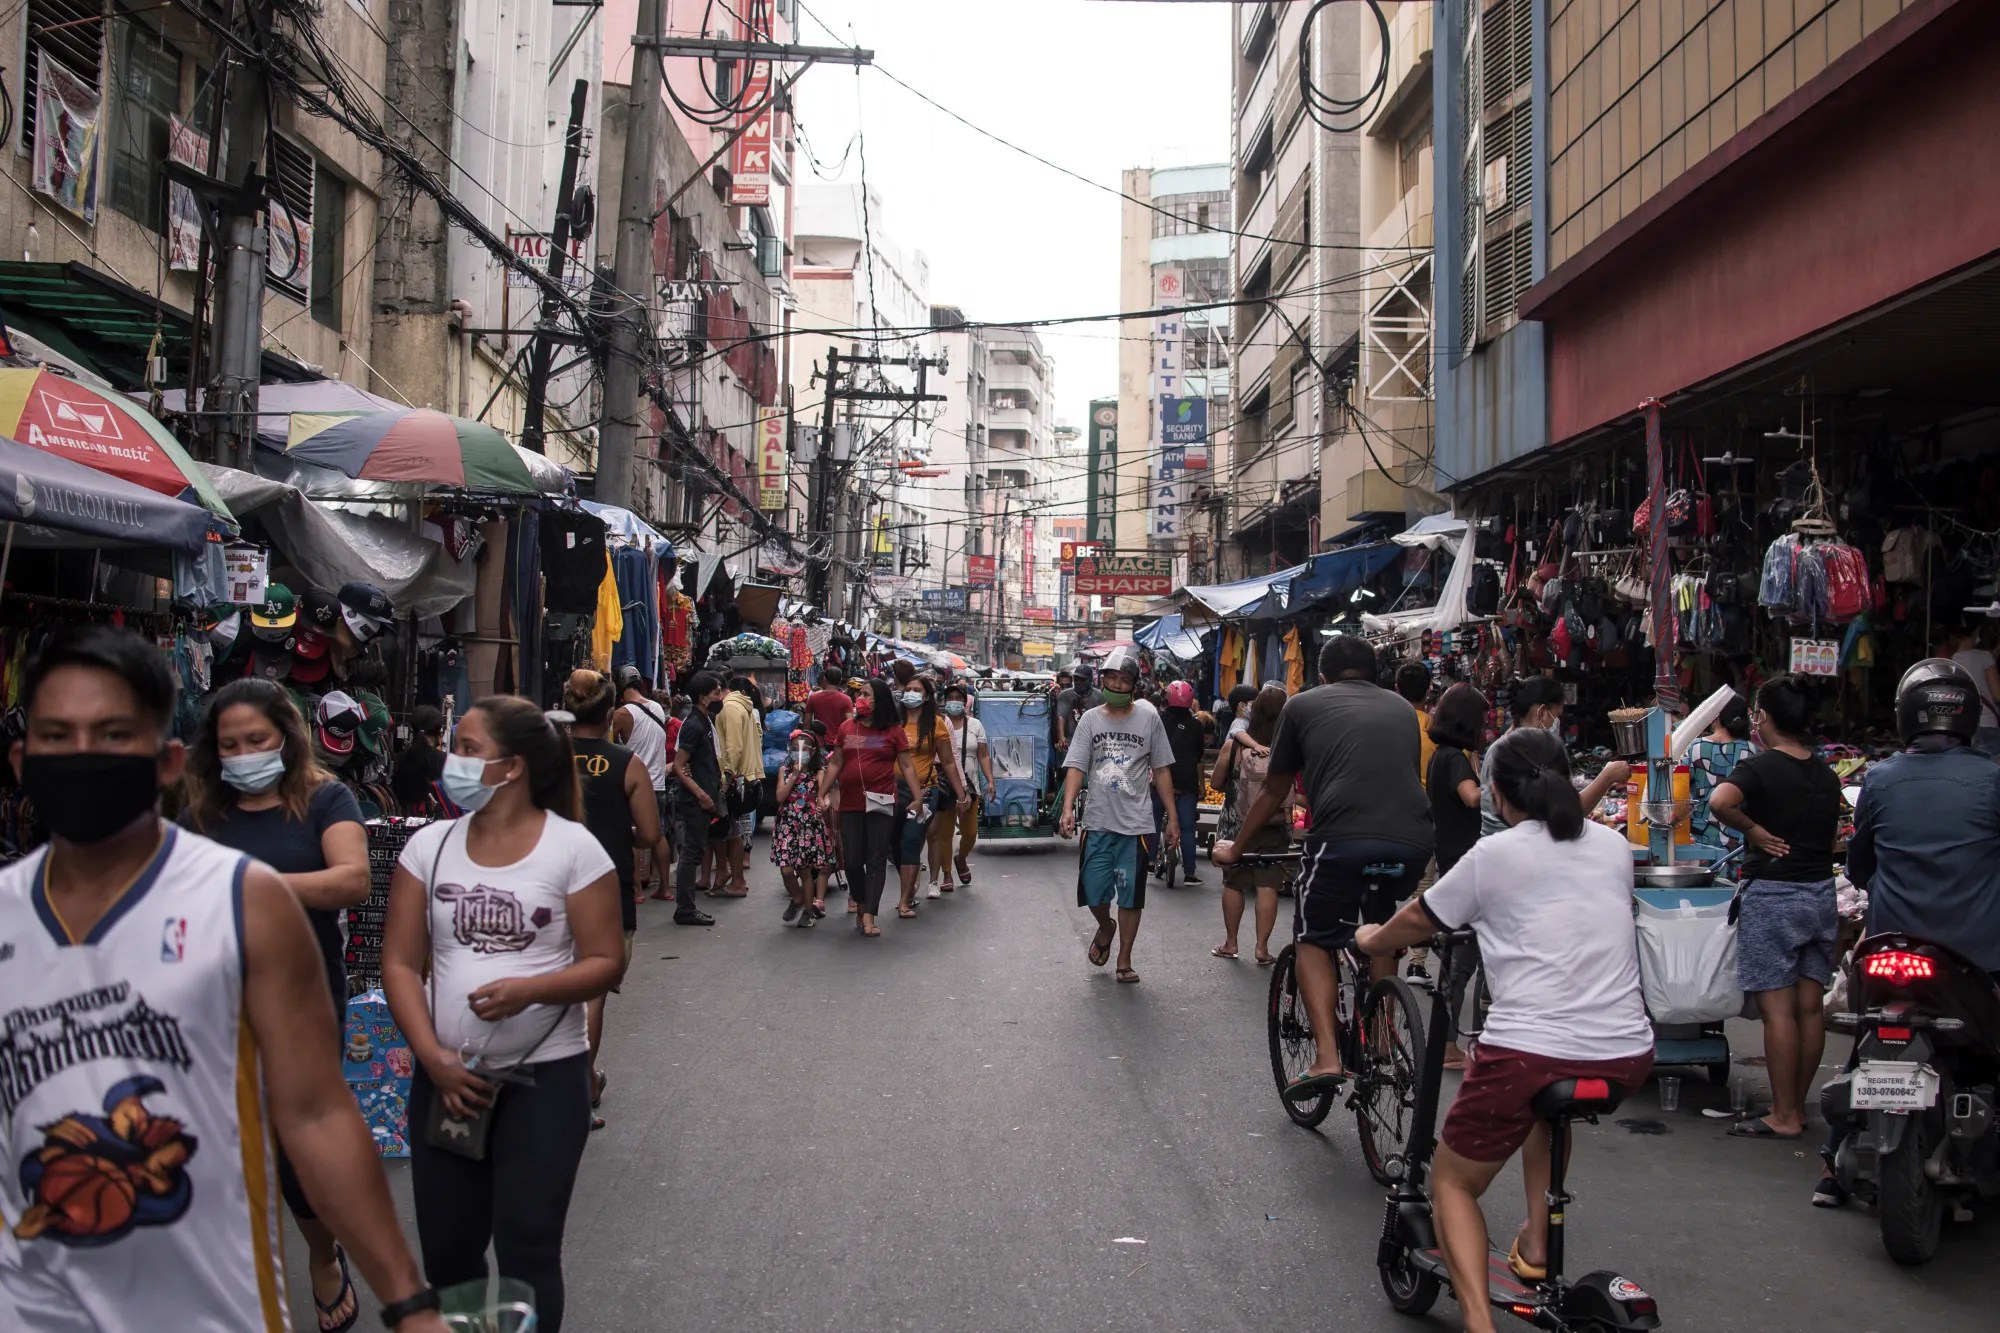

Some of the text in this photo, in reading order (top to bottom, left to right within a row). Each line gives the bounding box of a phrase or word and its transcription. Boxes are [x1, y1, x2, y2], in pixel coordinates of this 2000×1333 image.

[1166, 424, 1204, 433] SECURITY
[28, 423, 109, 454] AMERICAN
[1172, 431, 1197, 441] BANK
[764, 419, 783, 489] SALE
[1164, 452, 1184, 462] ATM
[41, 485, 144, 528] MICROMATIC
[1098, 557, 1169, 571] MACE
[1077, 579, 1170, 591] SHARP
[1792, 646, 1835, 674] 150
[1093, 731, 1145, 747] ONVERSE
[1856, 1087, 1917, 1097] 1303-0760642
